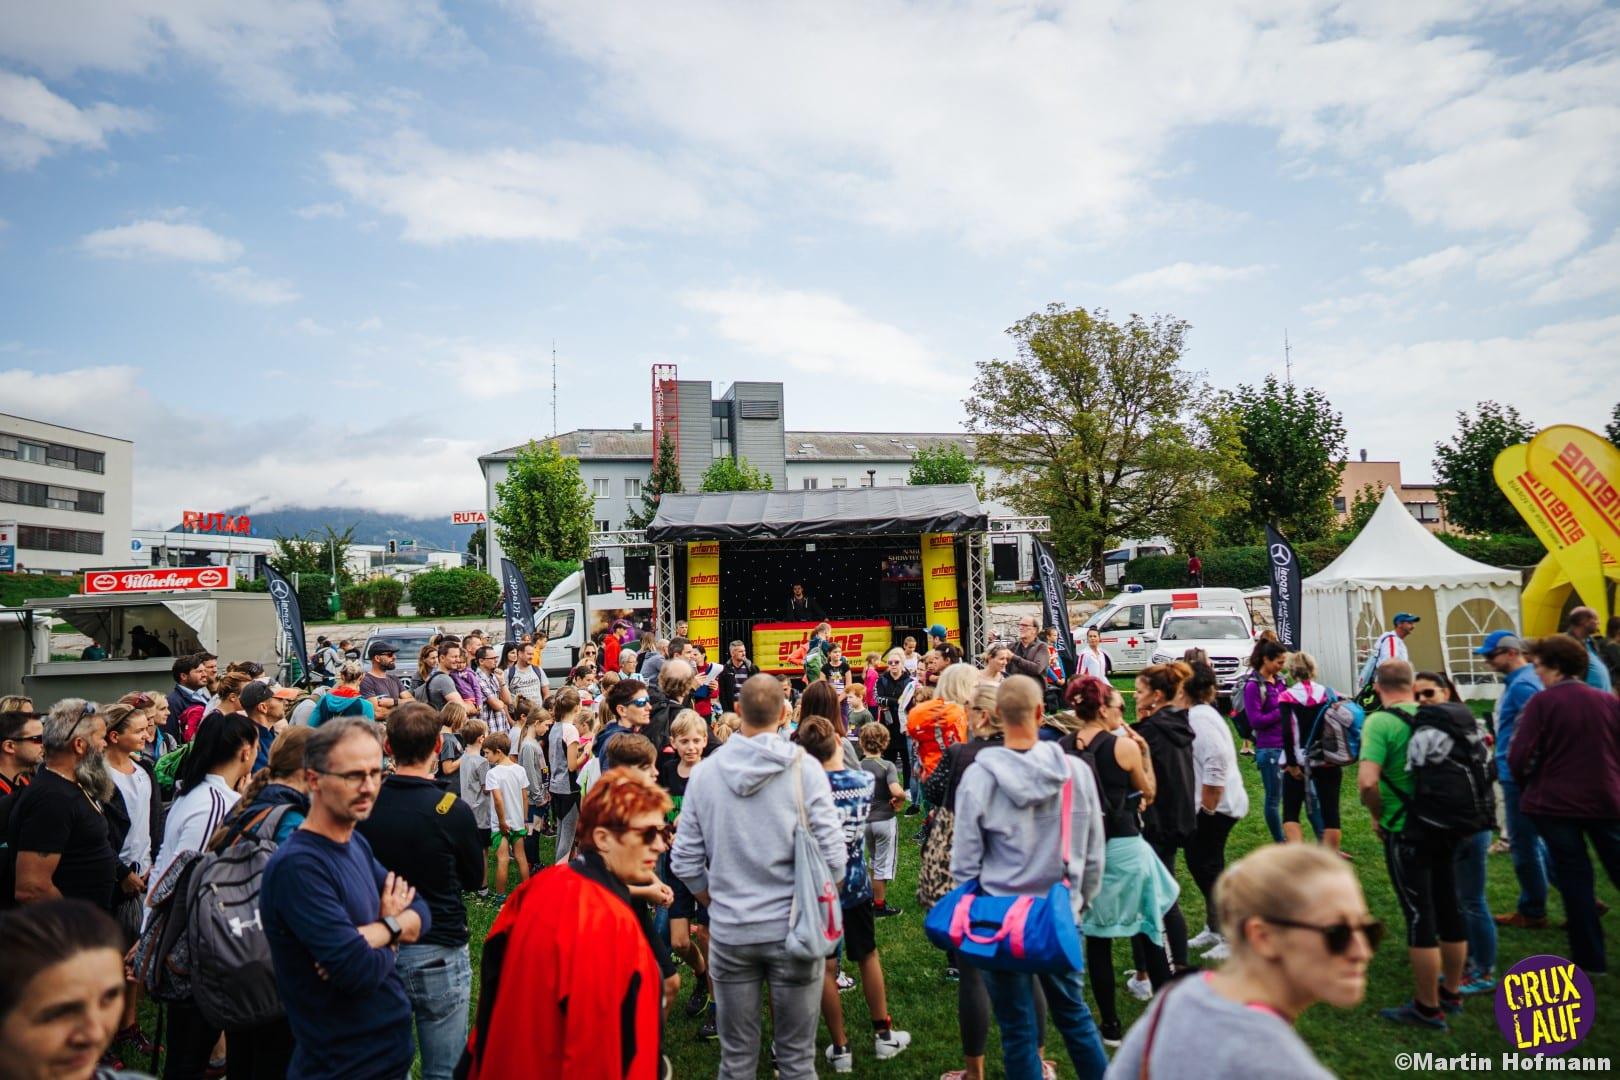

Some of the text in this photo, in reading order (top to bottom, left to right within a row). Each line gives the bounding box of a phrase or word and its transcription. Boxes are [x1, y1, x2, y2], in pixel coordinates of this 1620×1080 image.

[183, 511, 251, 535] RUTAR
[453, 512, 486, 523] RUTA
[121, 573, 194, 589] Villacher
[779, 632, 863, 655] antne
